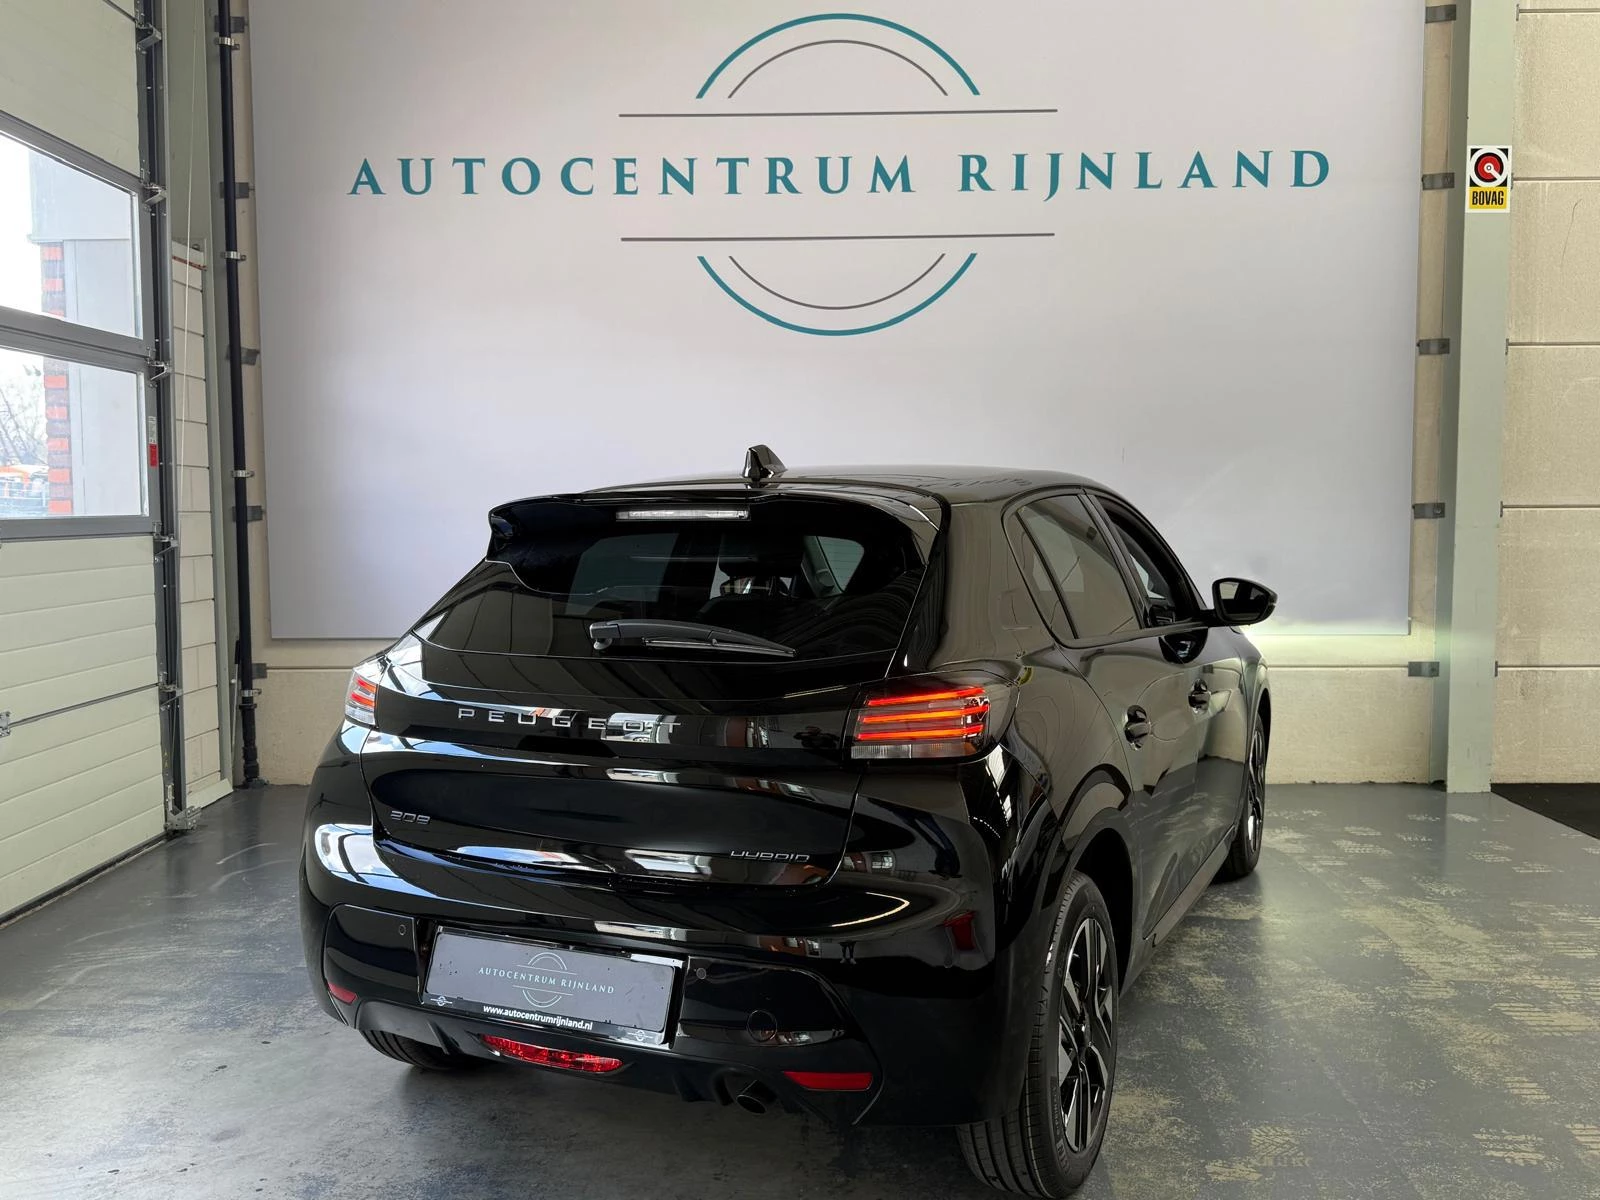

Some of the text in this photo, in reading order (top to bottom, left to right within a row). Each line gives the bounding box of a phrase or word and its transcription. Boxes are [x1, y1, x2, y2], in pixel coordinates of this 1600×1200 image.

[347, 149, 1330, 202] AUTOCENTRUM RIJNLAND
[1471, 190, 1505, 206] BOVAG
[457, 707, 682, 734] PEUGEOT
[390, 810, 431, 825] 208
[478, 967, 615, 994] AUTOCENTRUM RIJNLAND
[483, 1005, 594, 1031] www.autocentrumrijnland.nl
